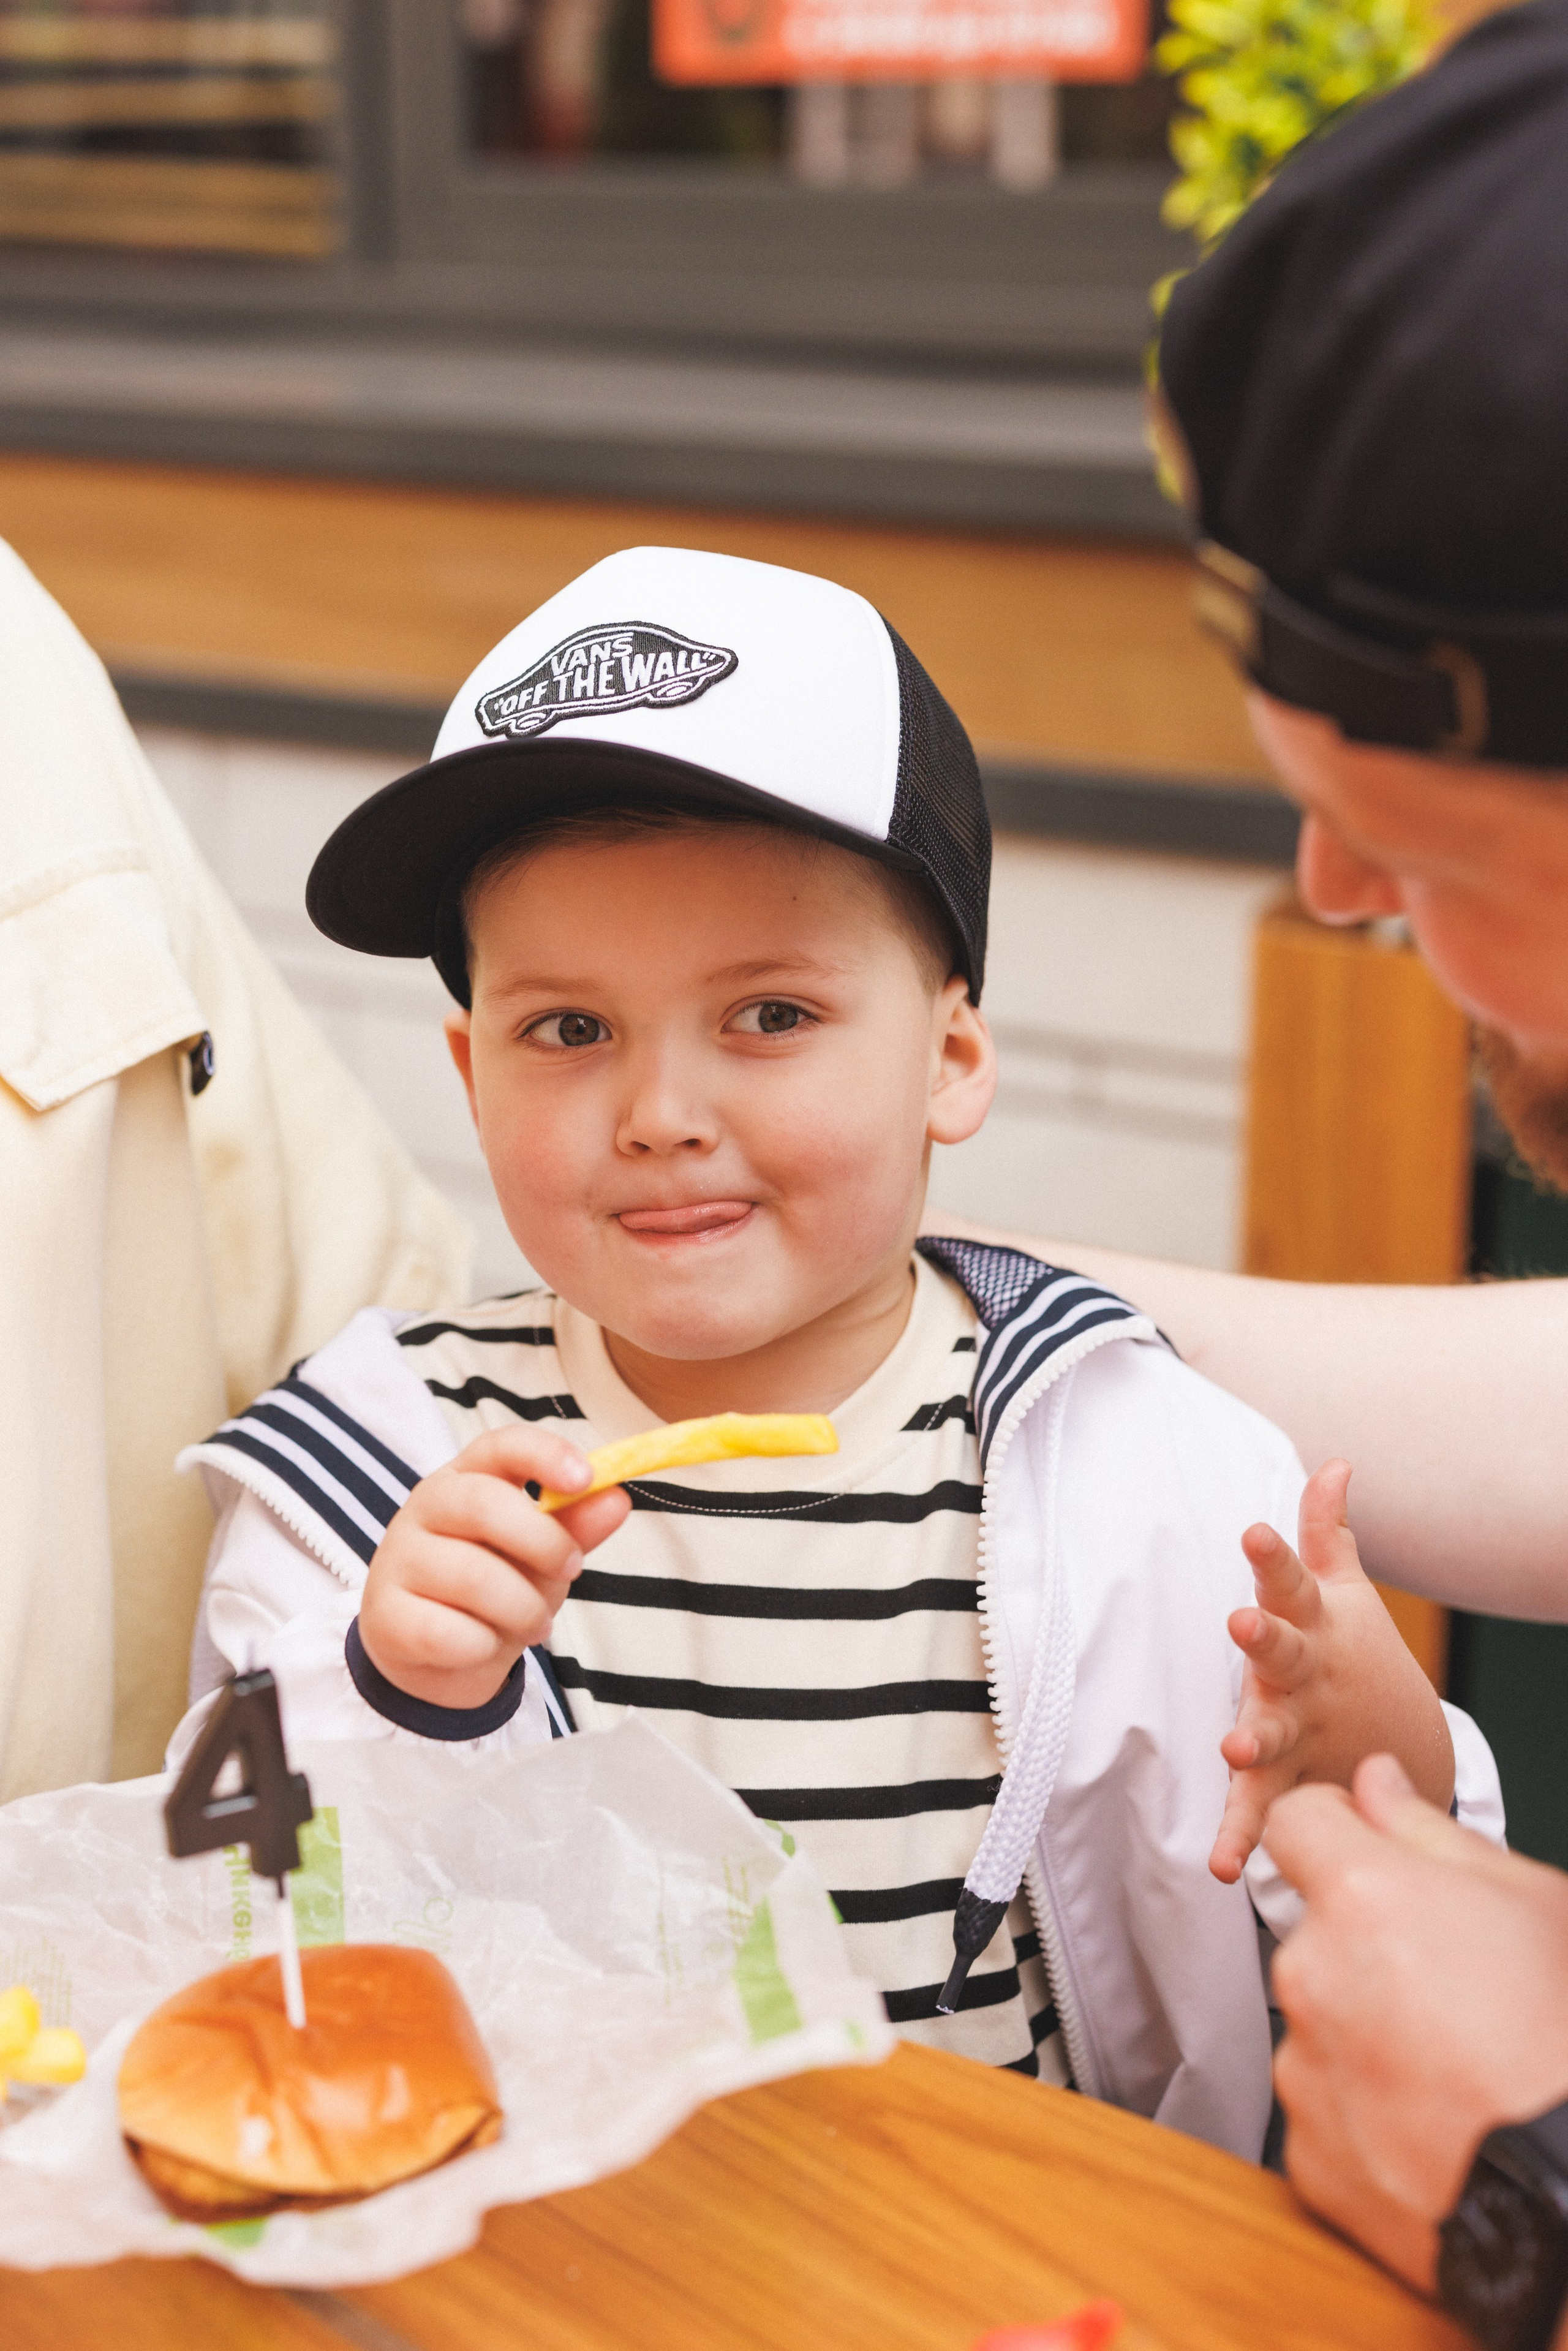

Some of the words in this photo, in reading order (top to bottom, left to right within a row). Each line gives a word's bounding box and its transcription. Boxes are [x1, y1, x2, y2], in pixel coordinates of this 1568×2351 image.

[551, 632, 634, 676] VANS
[552, 659, 615, 703] THE
[164, 1667, 314, 1879] 4
